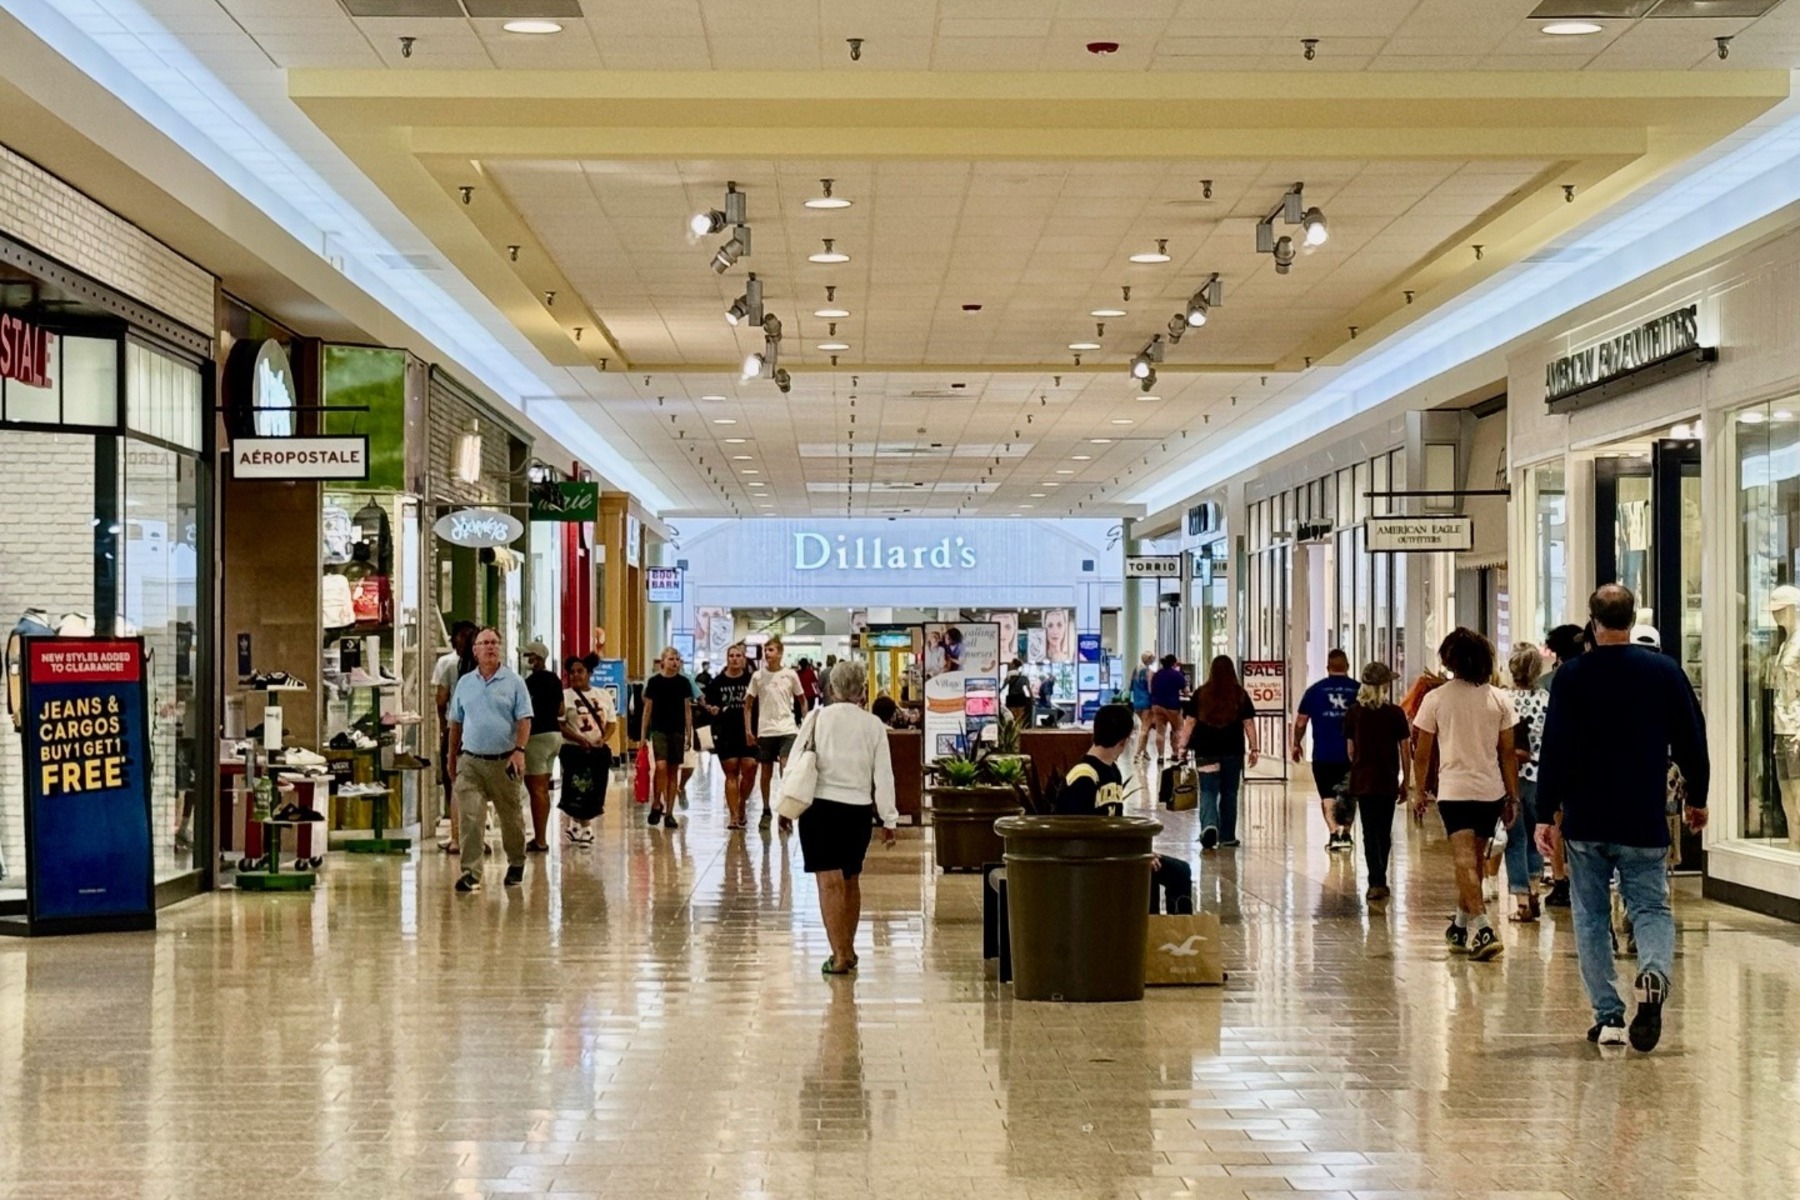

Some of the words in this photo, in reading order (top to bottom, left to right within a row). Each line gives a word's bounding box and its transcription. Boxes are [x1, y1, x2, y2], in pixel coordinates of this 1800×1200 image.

[239, 449, 360, 464] AÉROPOSTALE
[1377, 525, 1427, 535] AMERICAN
[1431, 525, 1462, 534] EAGLE
[793, 532, 976, 570] Dillard's
[1129, 562, 1176, 572] TORRID
[41, 653, 65, 663] NEW
[66, 652, 99, 662] STYLES
[100, 652, 131, 662] ADDED
[51, 663, 64, 673] TO
[1244, 664, 1284, 677] SALE
[39, 697, 102, 721] JEANS
[107, 695, 119, 713] &
[40, 716, 120, 742] CARGOS
[41, 742, 72, 762] BUY
[83, 738, 113, 756] GET
